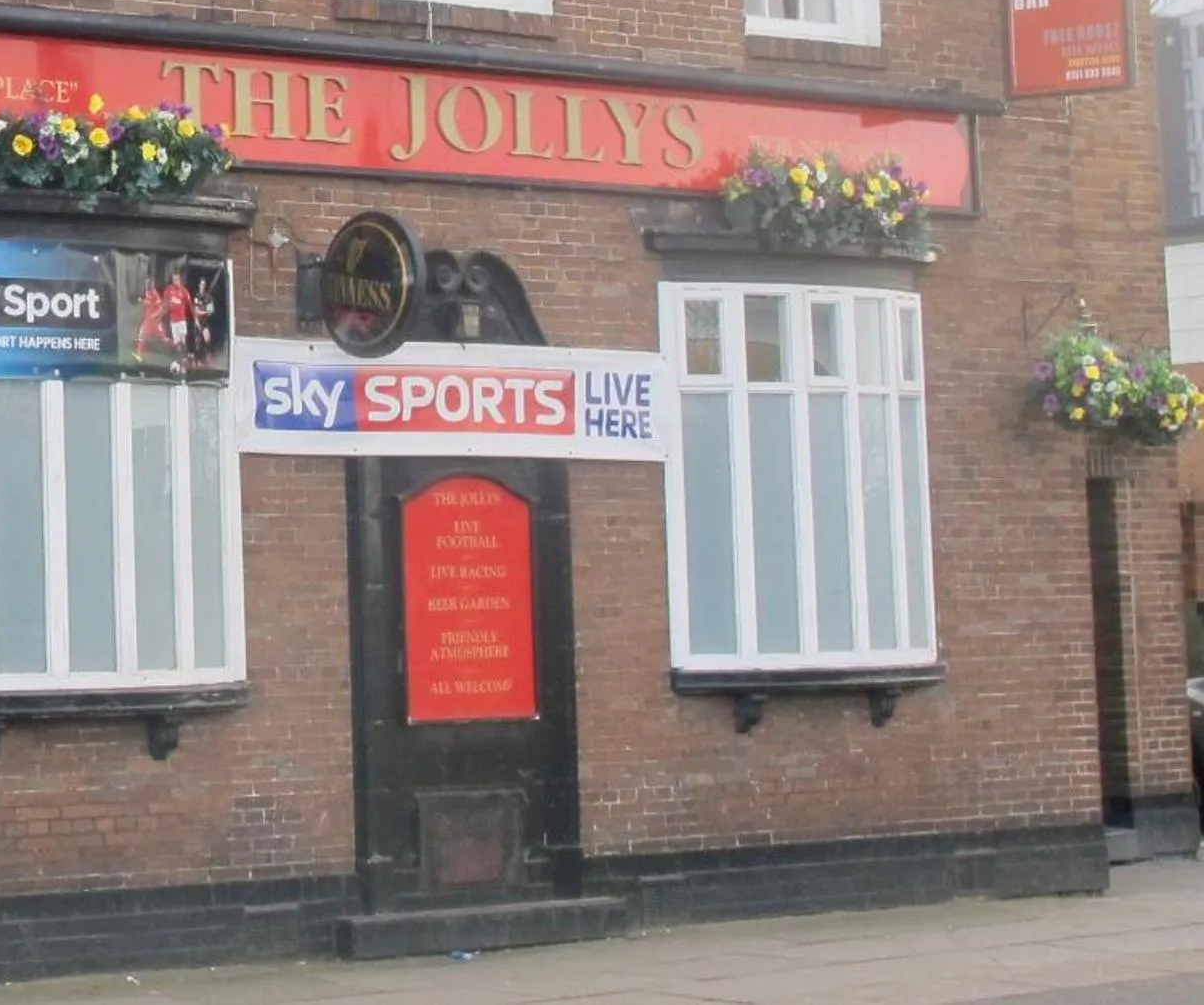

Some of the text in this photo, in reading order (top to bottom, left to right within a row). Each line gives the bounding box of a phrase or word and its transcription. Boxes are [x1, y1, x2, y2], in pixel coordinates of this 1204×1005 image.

[160, 59, 703, 170] THE JOLLYS
[3, 284, 101, 323] Sport
[19, 336, 72, 350] HAPPENS
[73, 337, 101, 351] HERE
[263, 365, 566, 428] sky SPORTS
[585, 371, 652, 407] LIVE
[585, 408, 653, 439] HERE
[434, 491, 459, 506] THE
[454, 520, 480, 534] LIVE
[436, 535, 499, 549] FOOTBALL
[431, 566, 507, 580] LIVE RACING
[428, 597, 511, 612] BEER GARDEN
[441, 631, 499, 645] FRIENDLY
[430, 647, 509, 662] ATMOSPHERE
[429, 680, 512, 695] ALL WELCOME
